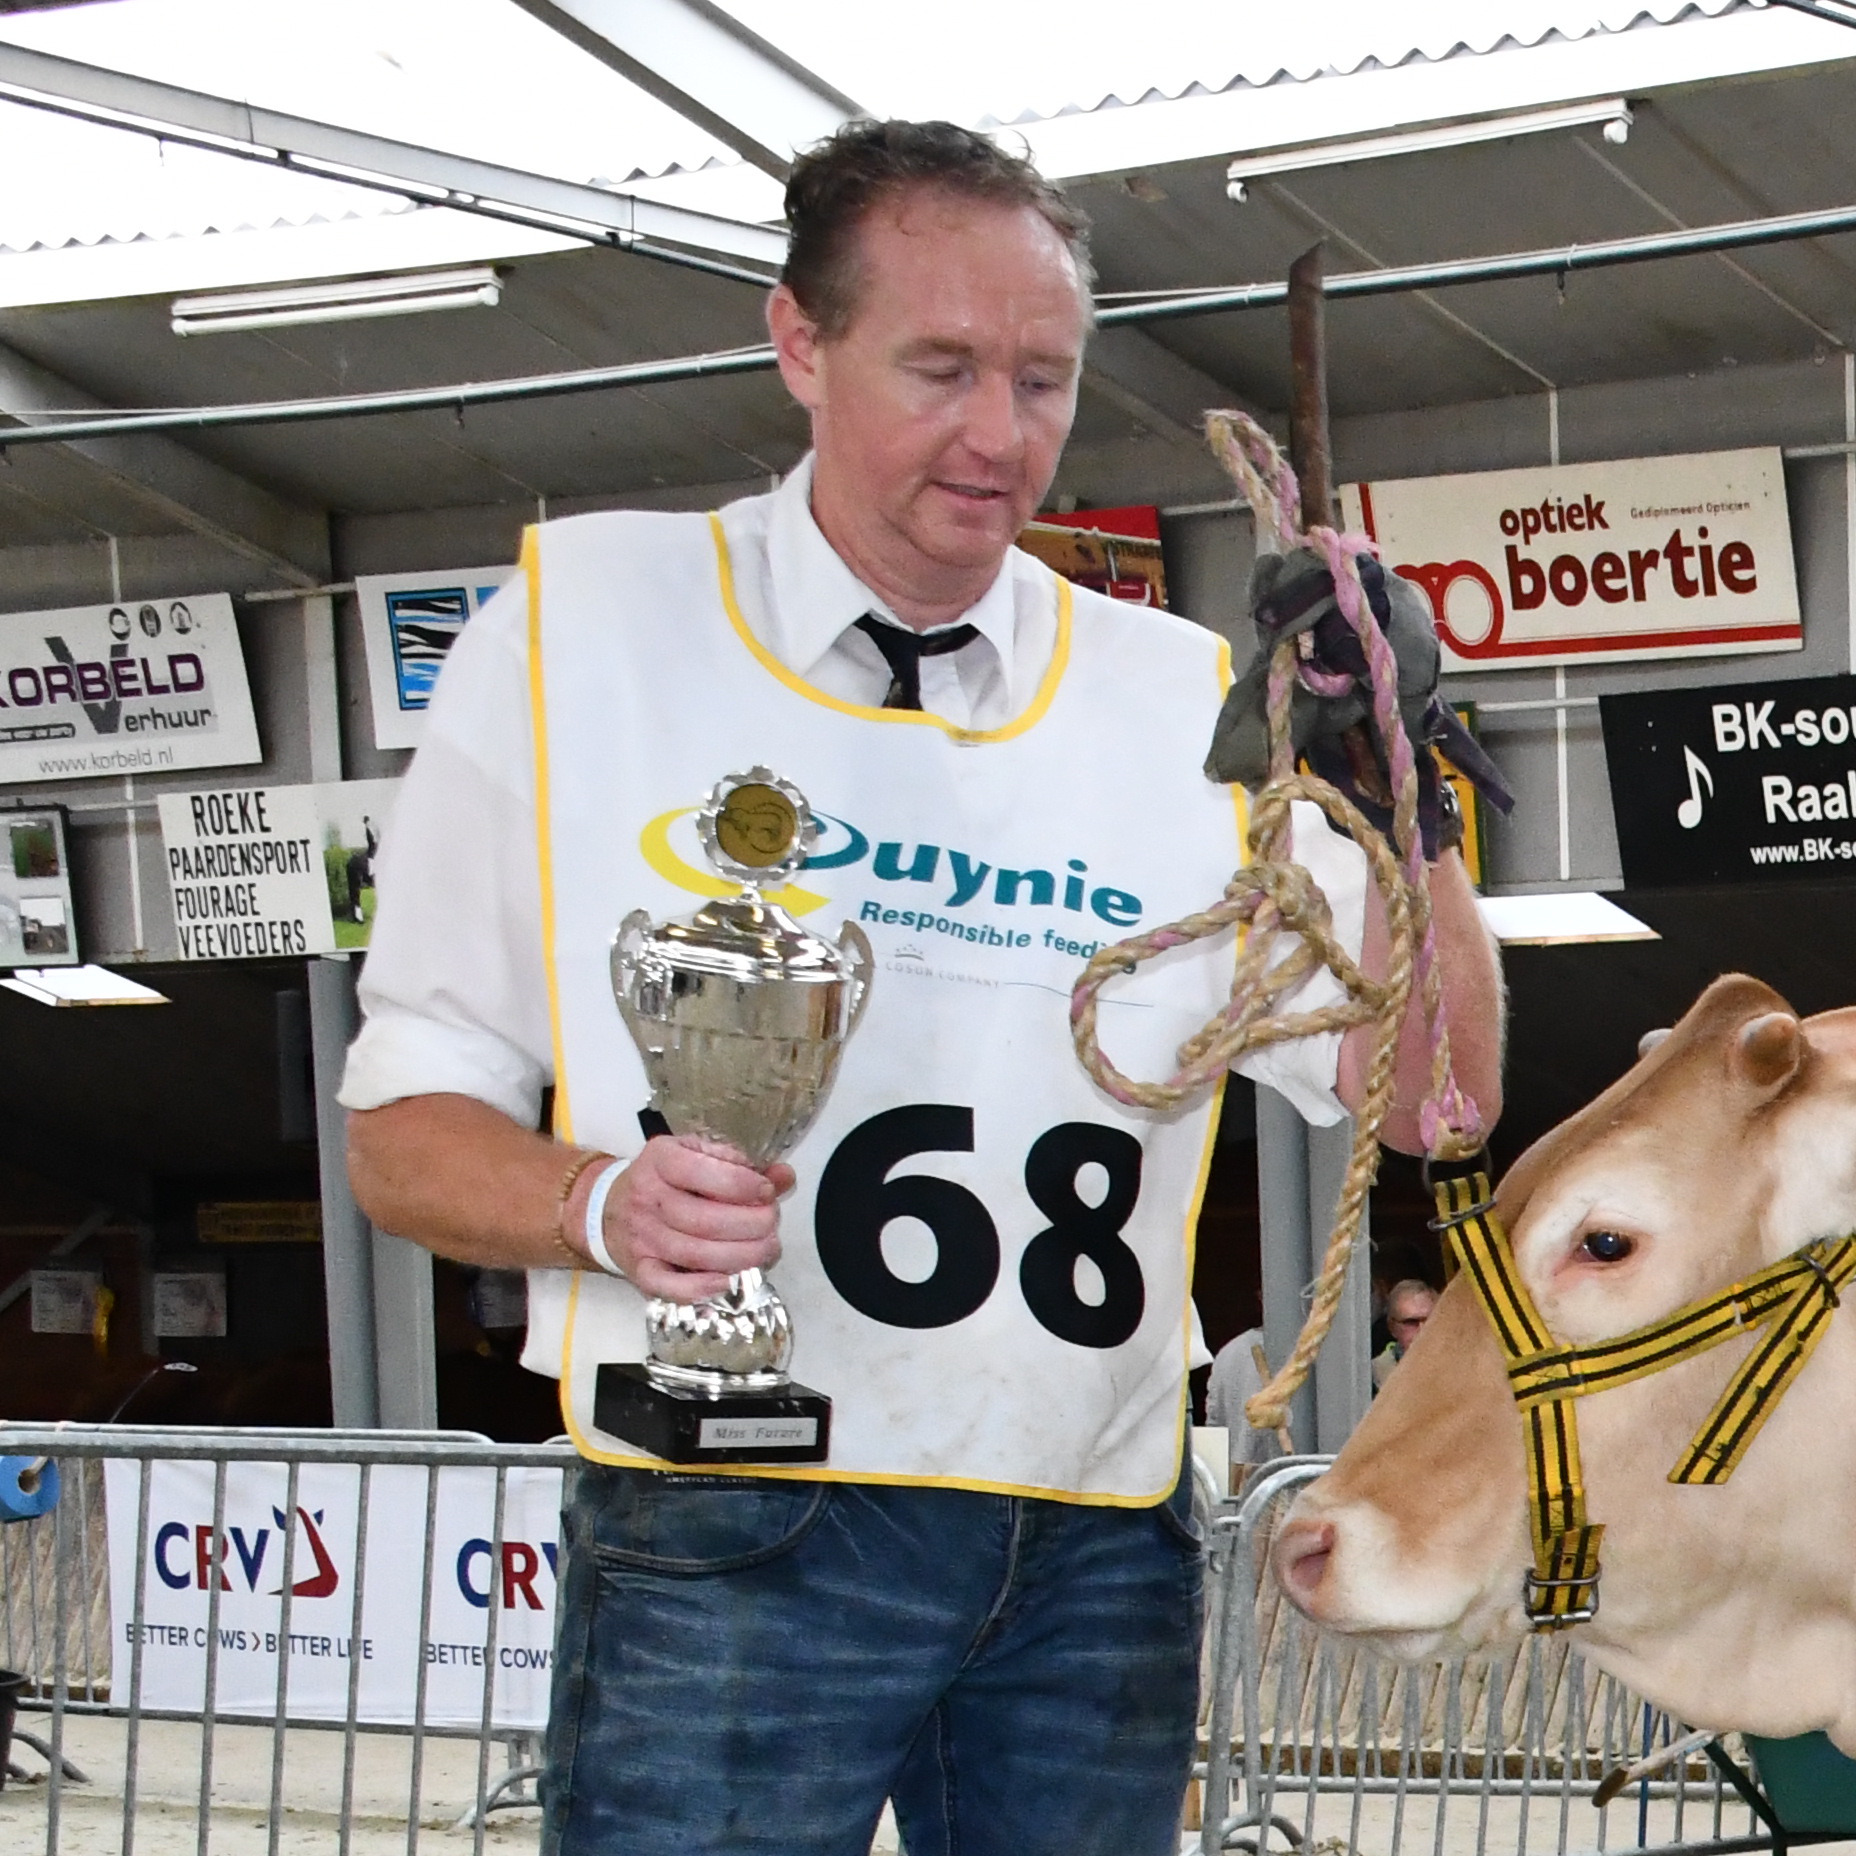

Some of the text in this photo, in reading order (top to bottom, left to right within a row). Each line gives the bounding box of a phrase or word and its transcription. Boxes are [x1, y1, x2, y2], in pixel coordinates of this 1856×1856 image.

[1499, 494, 1609, 545] optiek
[1504, 527, 1758, 611] boertie
[39, 746, 174, 773] www.korbeld.nl
[190, 791, 272, 837] ROEKE
[168, 838, 311, 881] PAARDENSPORT
[175, 883, 261, 921] FOURAGE
[860, 900, 1032, 948] Responsible
[178, 919, 307, 959] VEEVOEDERS
[155, 1521, 271, 1593] CRV
[194, 1628, 247, 1650] CWS
[266, 1632, 332, 1657] BTTER
